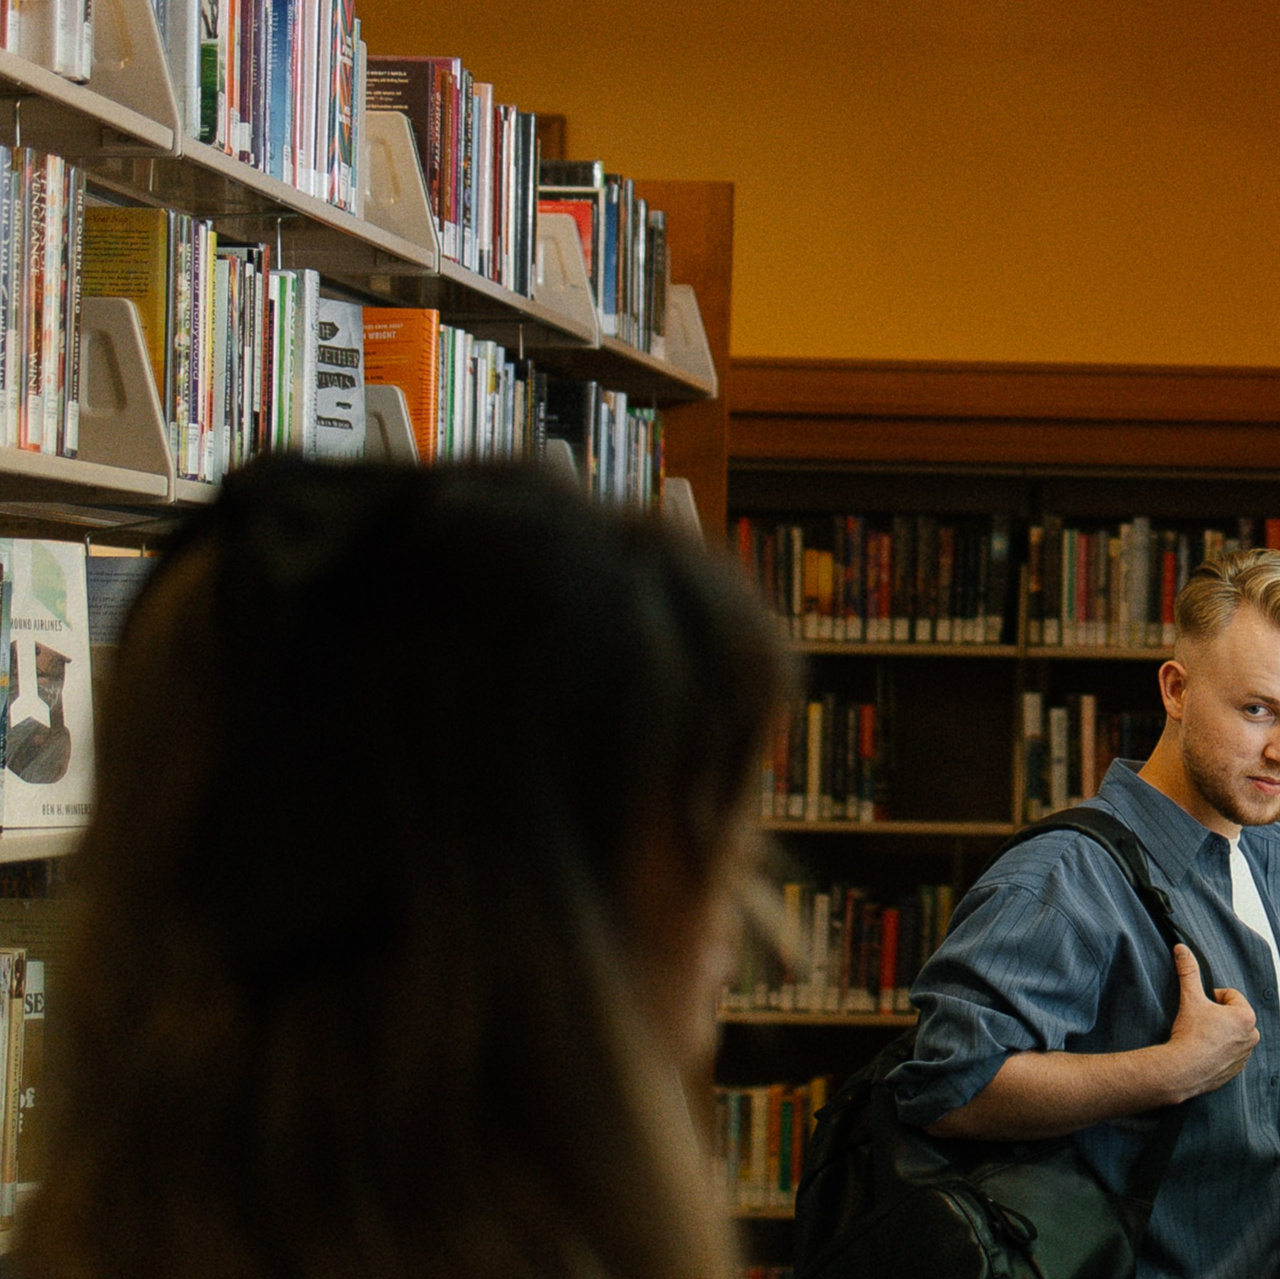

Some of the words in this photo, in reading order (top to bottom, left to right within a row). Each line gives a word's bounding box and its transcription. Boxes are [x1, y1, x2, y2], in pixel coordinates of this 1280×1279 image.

[75, 217, 83, 270] FOURTH
[74, 275, 82, 314] CHILD
[191, 301, 200, 381] hollywood
[33, 619, 63, 632] AIRLINES
[41, 803, 55, 816] BEN
